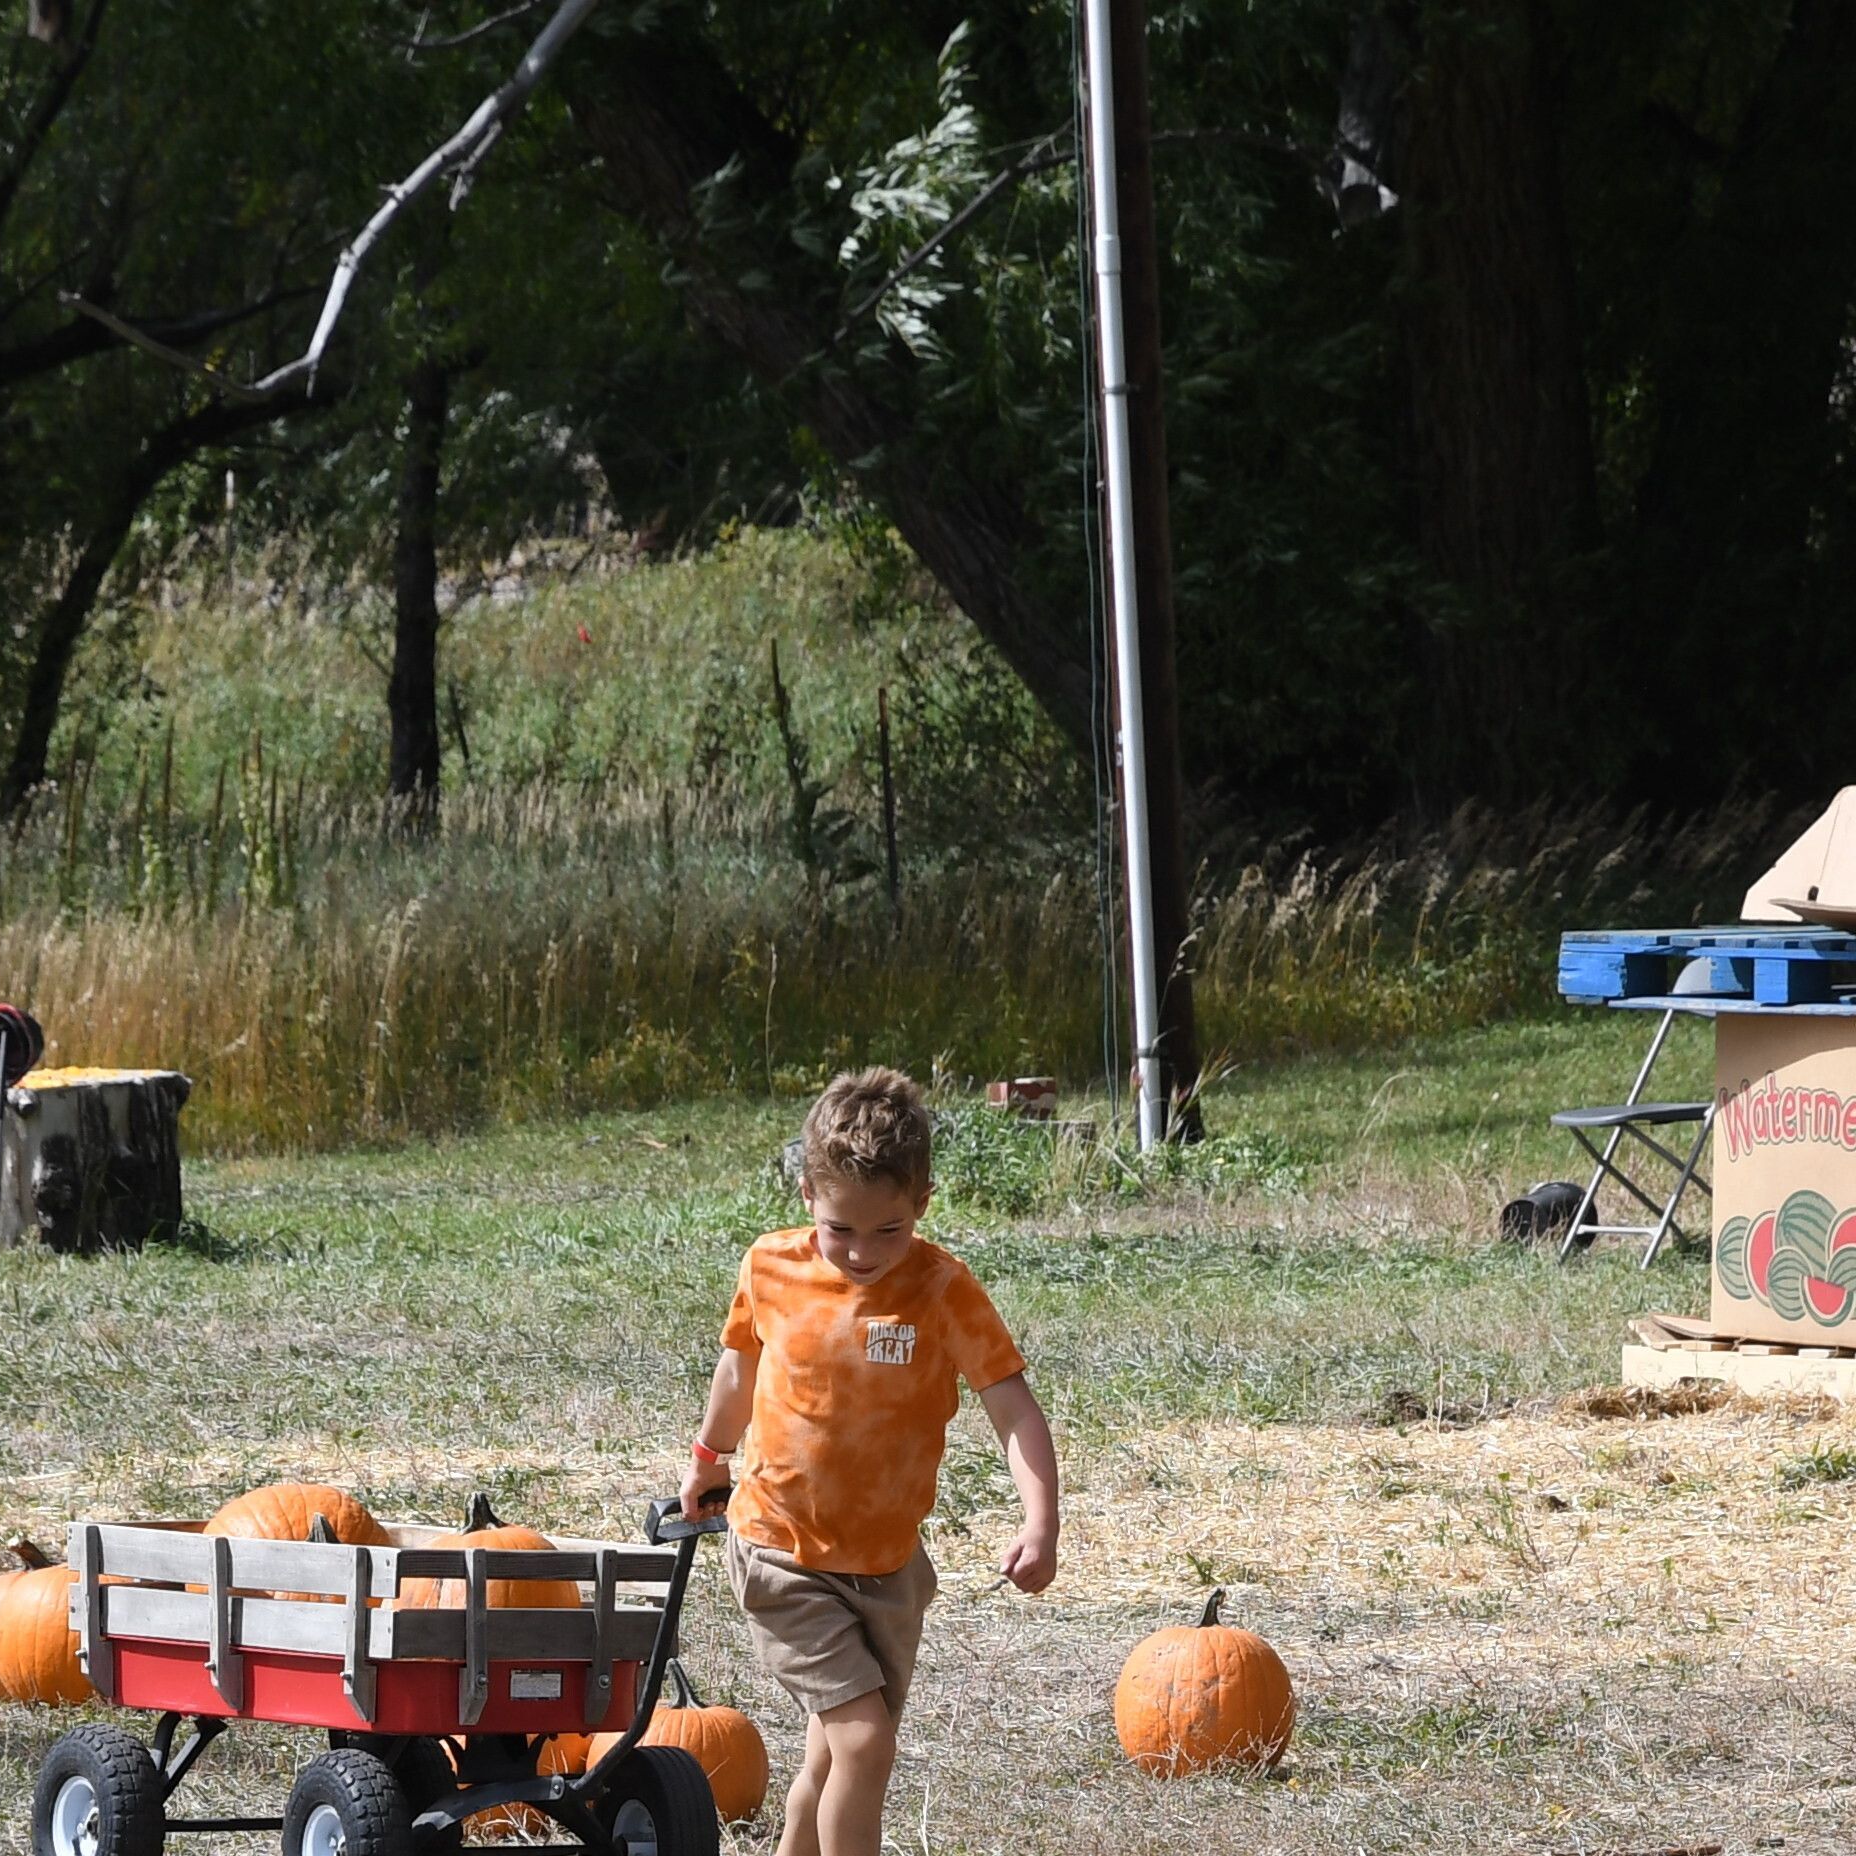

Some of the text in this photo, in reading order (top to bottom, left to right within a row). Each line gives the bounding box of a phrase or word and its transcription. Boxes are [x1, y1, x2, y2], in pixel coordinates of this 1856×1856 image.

[866, 1321, 916, 1348] TRICK OR
[865, 1339, 915, 1365] TREAT
